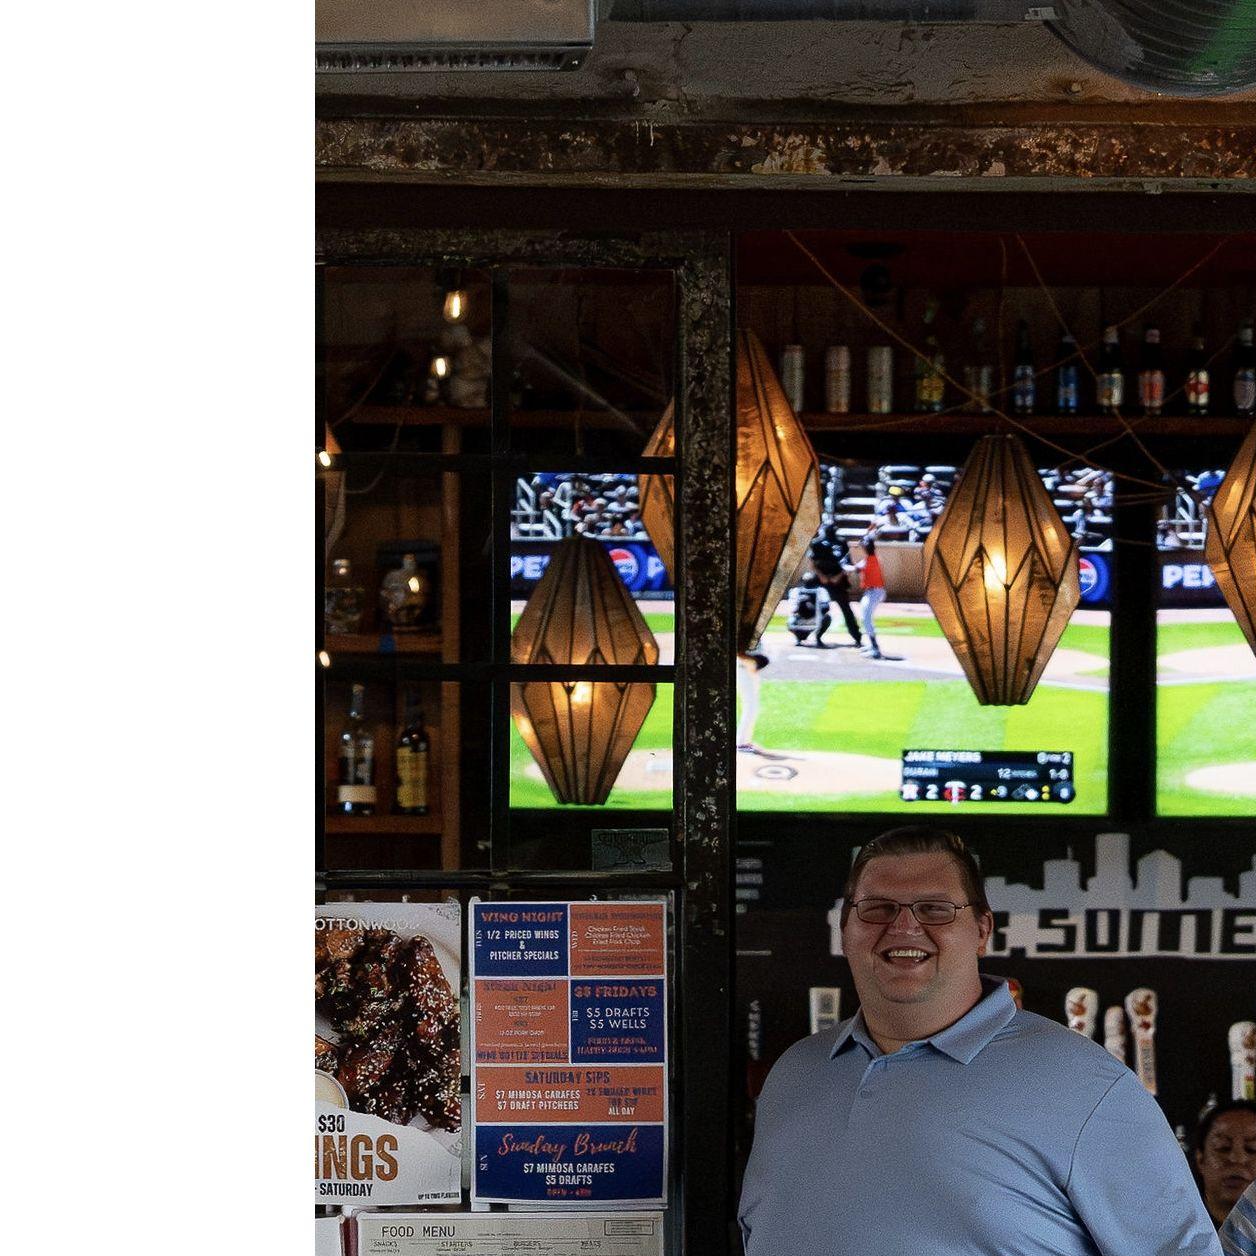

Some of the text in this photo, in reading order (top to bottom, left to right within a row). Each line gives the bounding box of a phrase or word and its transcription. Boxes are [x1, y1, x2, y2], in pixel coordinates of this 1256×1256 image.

[904, 751, 935, 763] JAKE
[925, 784, 939, 799] 2
[970, 785, 982, 800] 2
[482, 911, 563, 923] WING NIGHT
[487, 930, 559, 939] 1/2 PRICED WINGS
[519, 941, 525, 949] &
[490, 950, 559, 960] PITCHER SPECIALS
[573, 985, 657, 998] $5 FRIDAYS
[586, 1007, 650, 1017] $5 DRAFTS
[590, 1019, 647, 1029] $5 WELLS
[525, 1071, 611, 1084] SATURDAY SIPS
[496, 1090, 505, 1099] $7
[508, 1090, 542, 1099] MIMOSA
[545, 1089, 580, 1099] CARAFES
[497, 1101, 579, 1110] $7 DRAFT PITCHERS
[608, 1107, 635, 1115] ALL DAY
[318, 1114, 345, 1132] $30
[498, 1127, 638, 1162] Sunday Brunch
[523, 1163, 615, 1174] $7 MIMOSA CARAFES
[545, 1175, 592, 1185] $5 DRAFTS
[320, 1183, 373, 1196] SATURDAY
[381, 1226, 456, 1238] FOOD MENU
